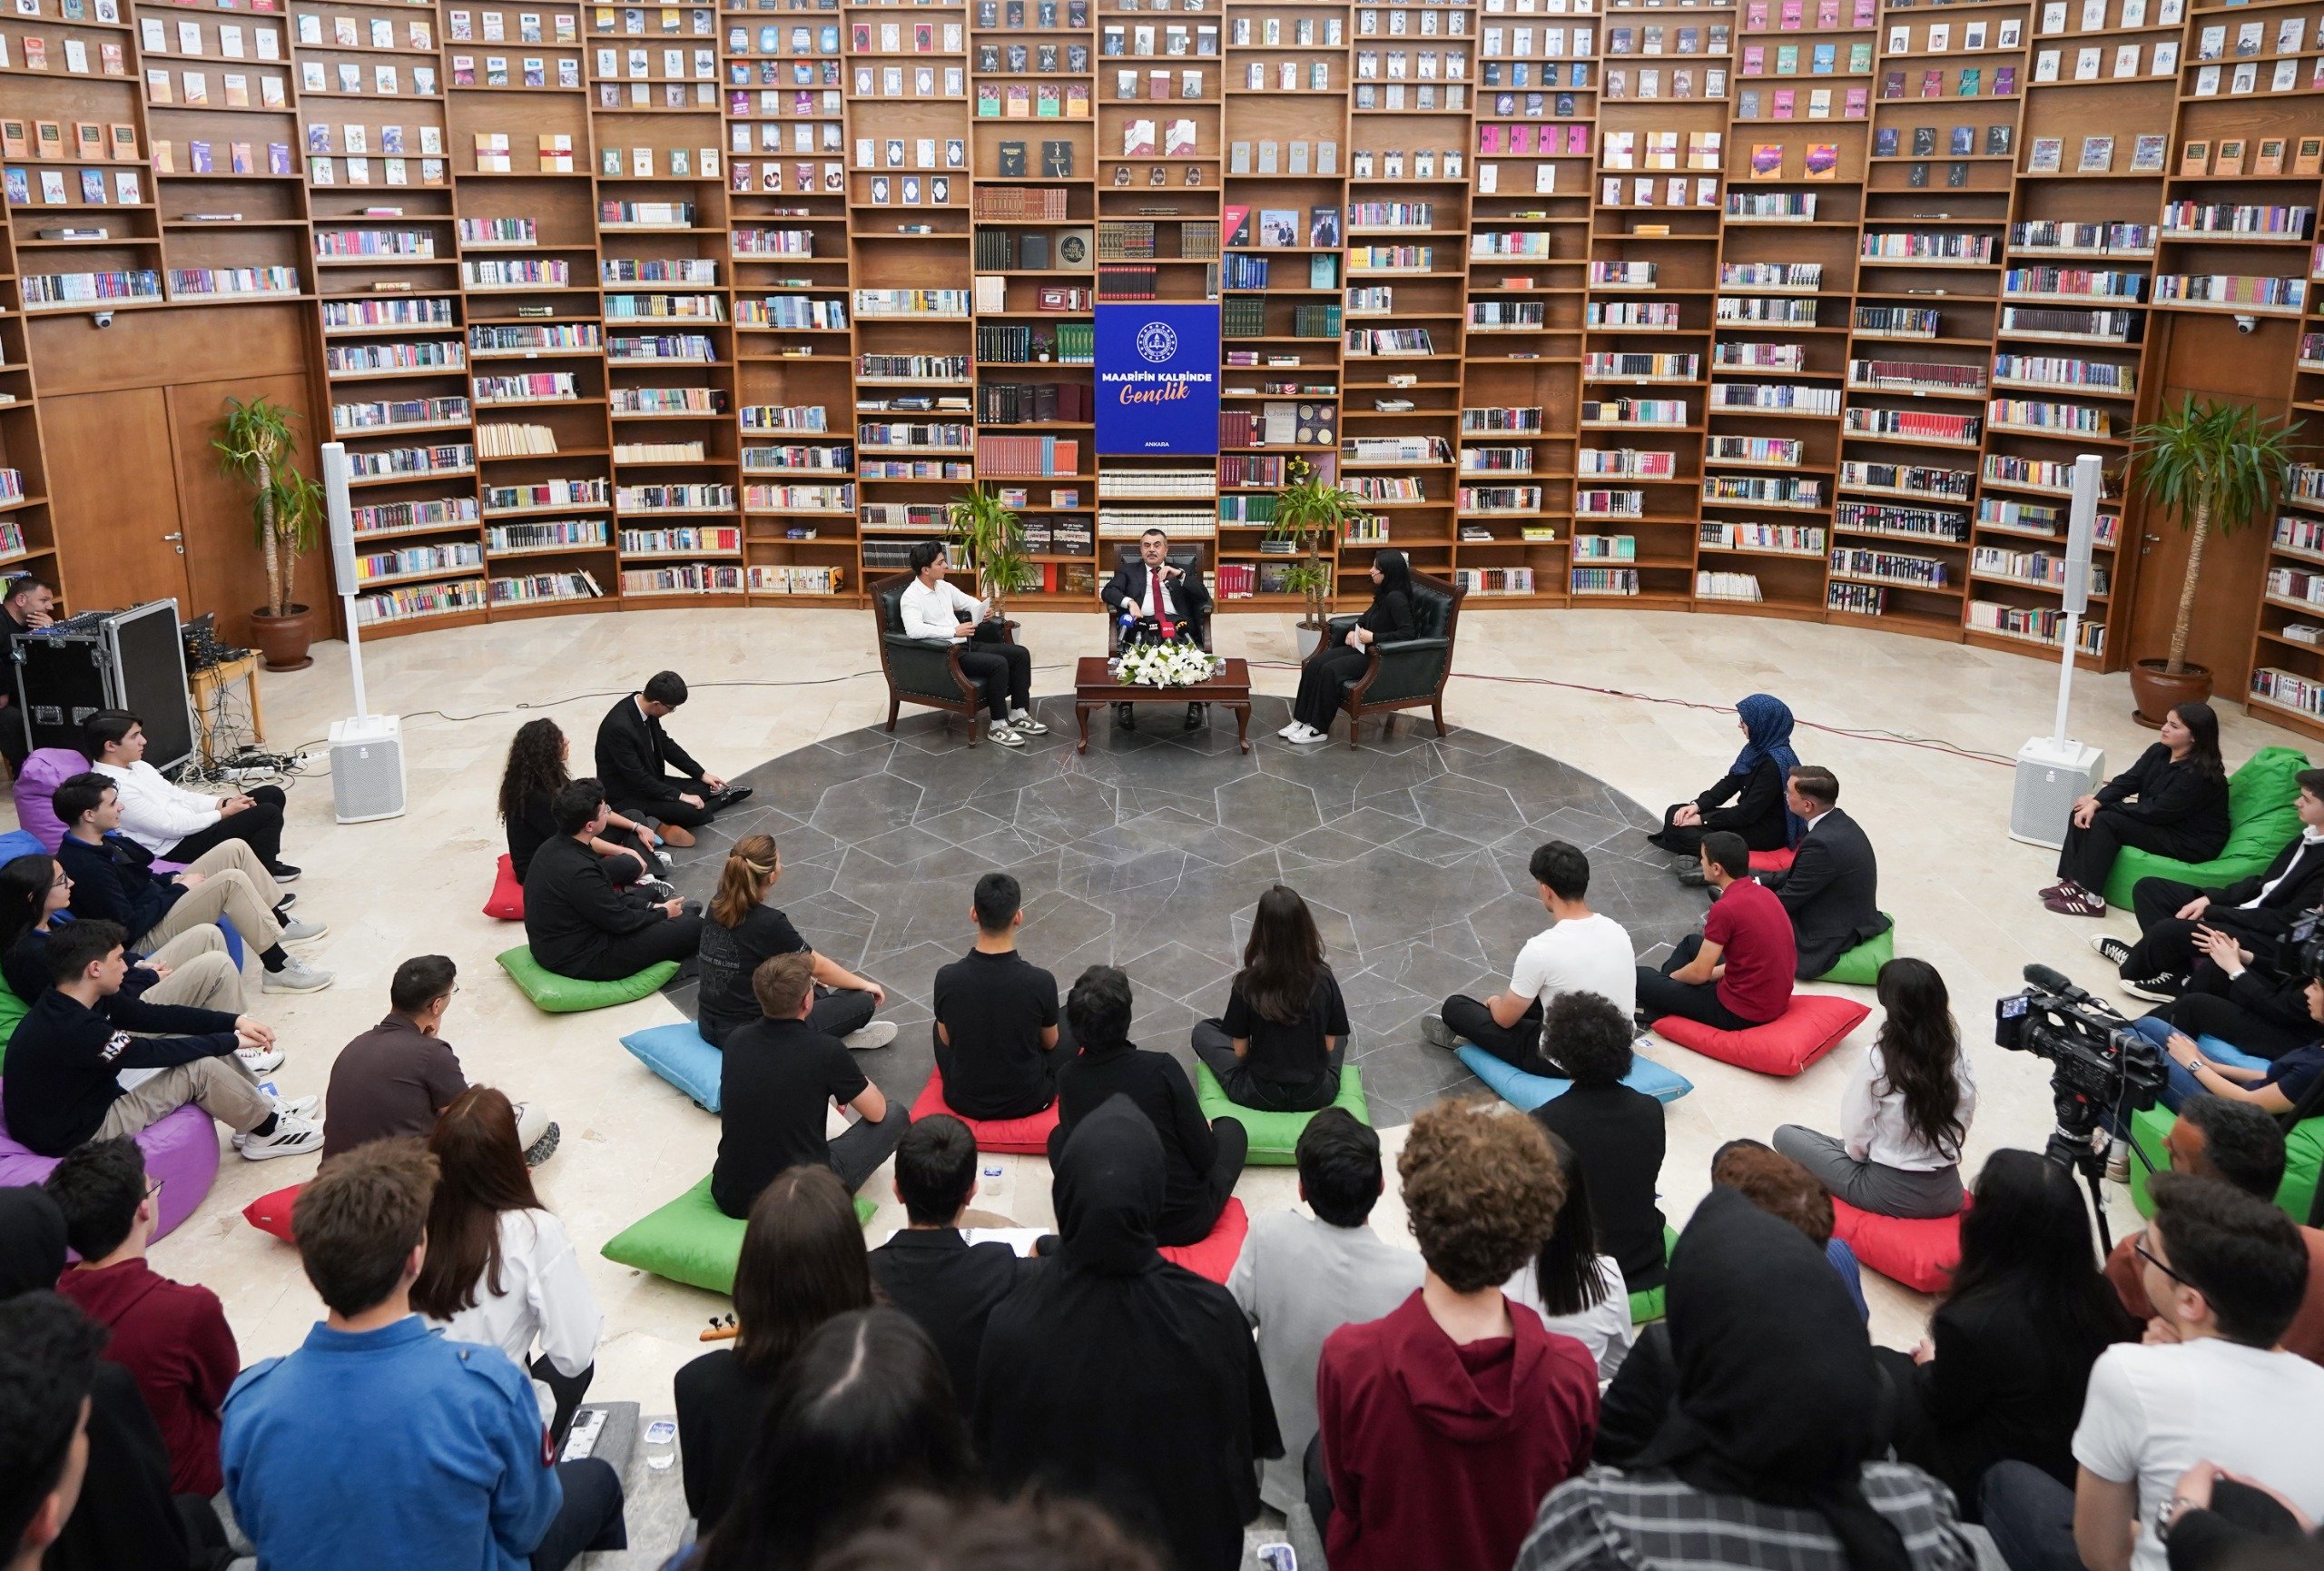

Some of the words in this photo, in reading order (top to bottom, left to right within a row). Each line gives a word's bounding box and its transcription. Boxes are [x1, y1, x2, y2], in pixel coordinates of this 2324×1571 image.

[1102, 371, 1155, 381] MAARİFİN
[1157, 371, 1212, 381] KALBİNDE
[1119, 380, 1190, 405] Gençlik
